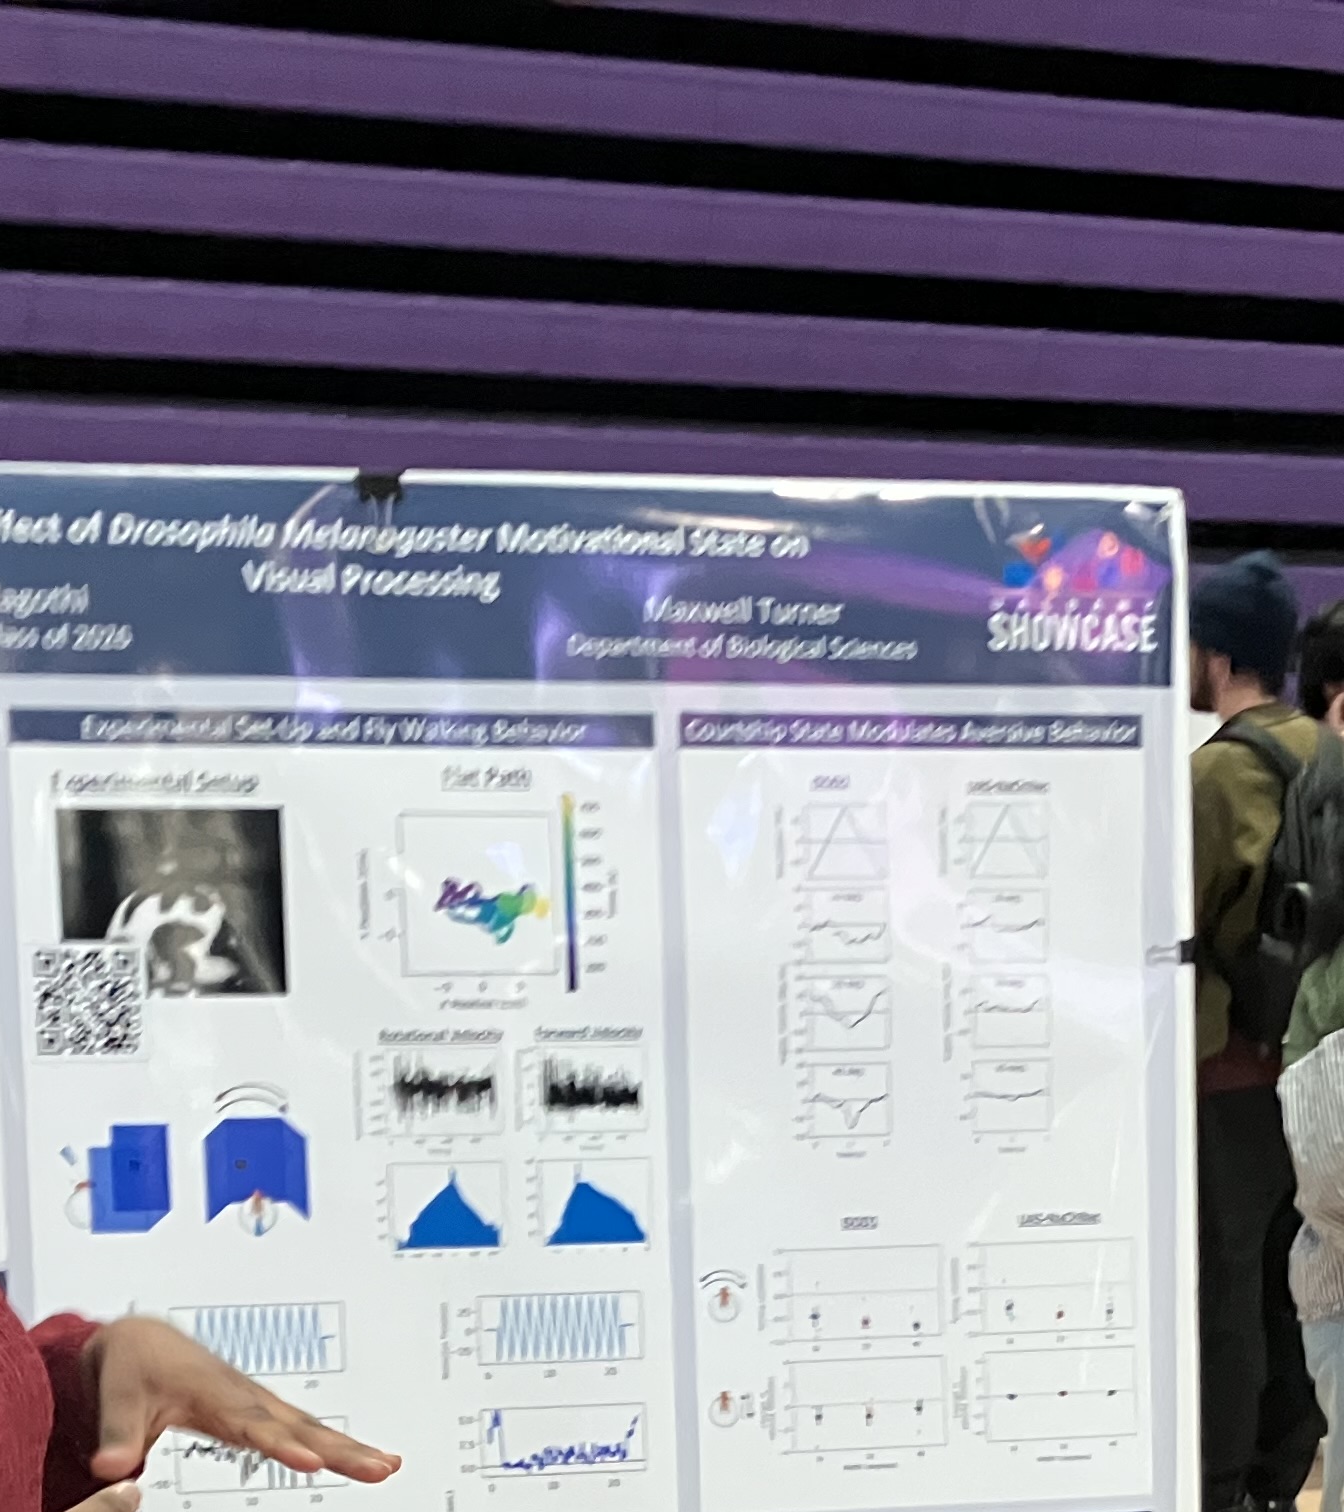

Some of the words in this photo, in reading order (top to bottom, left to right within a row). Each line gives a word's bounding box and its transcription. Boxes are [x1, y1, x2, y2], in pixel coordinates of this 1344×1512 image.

[67, 510, 103, 545] of
[107, 512, 277, 553] Drosophila
[280, 516, 494, 558] Melanogaster
[497, 521, 686, 556] Motivational
[689, 526, 767, 558] State
[770, 533, 811, 559] on
[241, 559, 336, 593] Visual
[341, 563, 501, 604] Processing
[643, 595, 753, 624] Maxwell
[756, 597, 844, 626] Turner
[987, 611, 1157, 652] SHOWCASE
